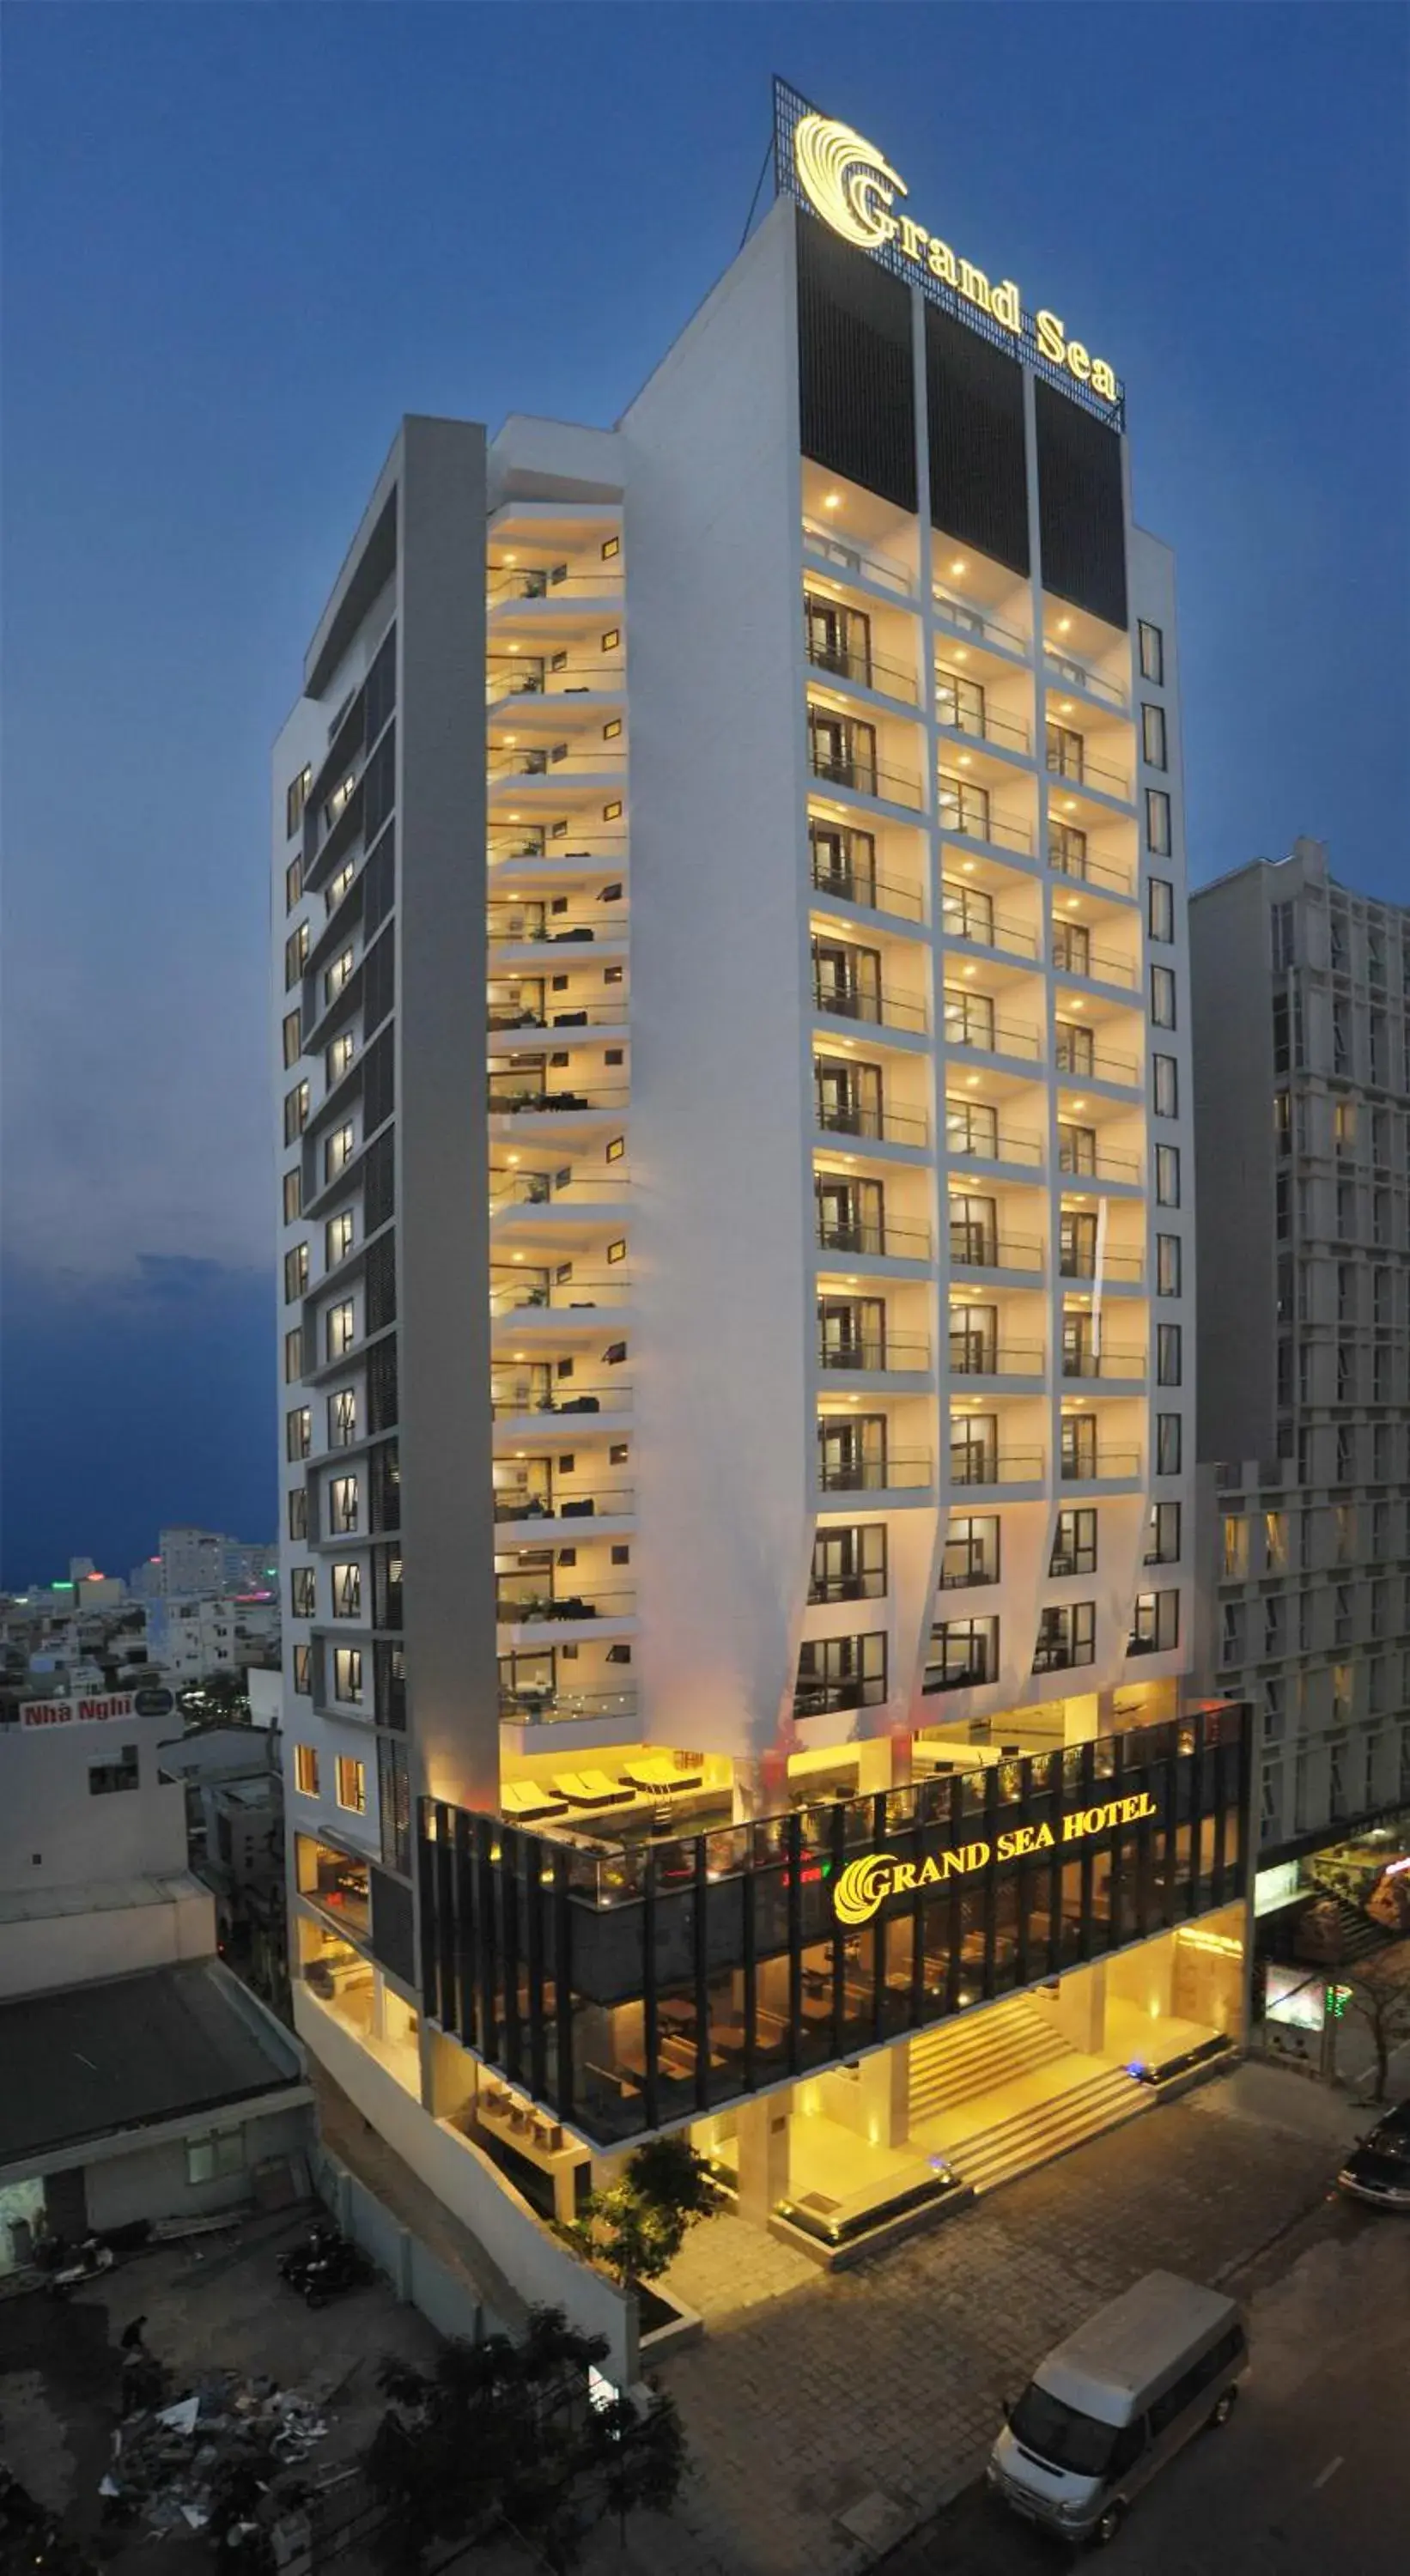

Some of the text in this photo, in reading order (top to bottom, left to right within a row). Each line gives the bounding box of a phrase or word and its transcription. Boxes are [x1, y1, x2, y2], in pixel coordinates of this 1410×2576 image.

[852, 174, 1117, 401] Grand Sea
[25, 1702, 72, 1726] Nhà
[866, 1793, 1156, 1901] GRAND SEA HOTEL
